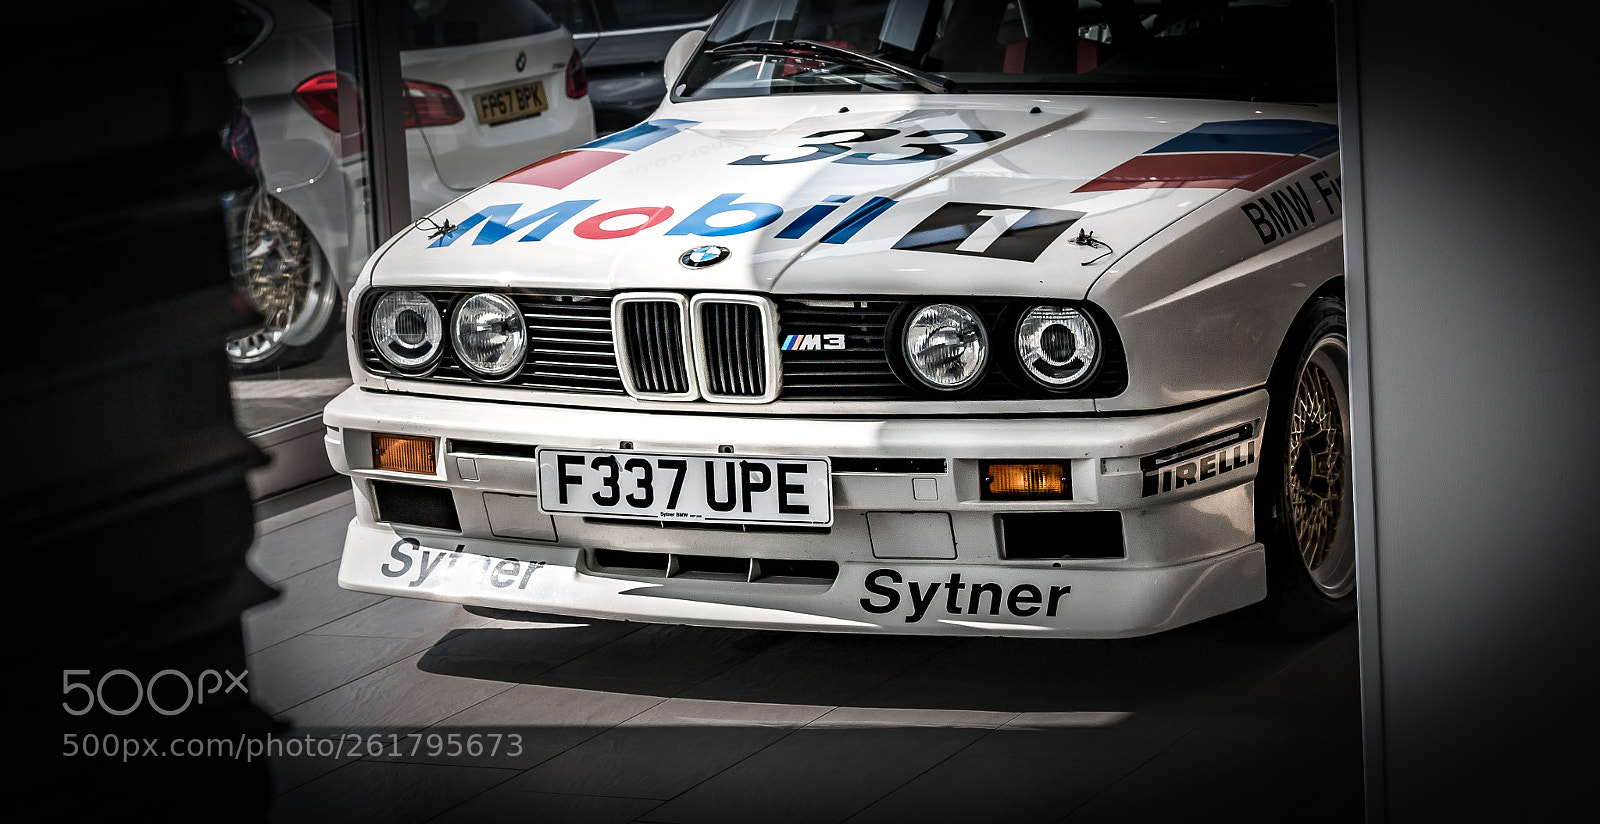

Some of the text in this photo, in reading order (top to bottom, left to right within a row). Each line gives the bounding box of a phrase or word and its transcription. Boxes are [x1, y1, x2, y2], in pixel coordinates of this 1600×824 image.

[727, 129, 1006, 166] 33
[428, 192, 899, 249] Mobil
[1241, 181, 1316, 246] BMW
[799, 333, 846, 351] M3
[557, 454, 811, 516] F337 UPE
[1139, 420, 1255, 498] PIRELLI
[859, 568, 1072, 623] Sytner
